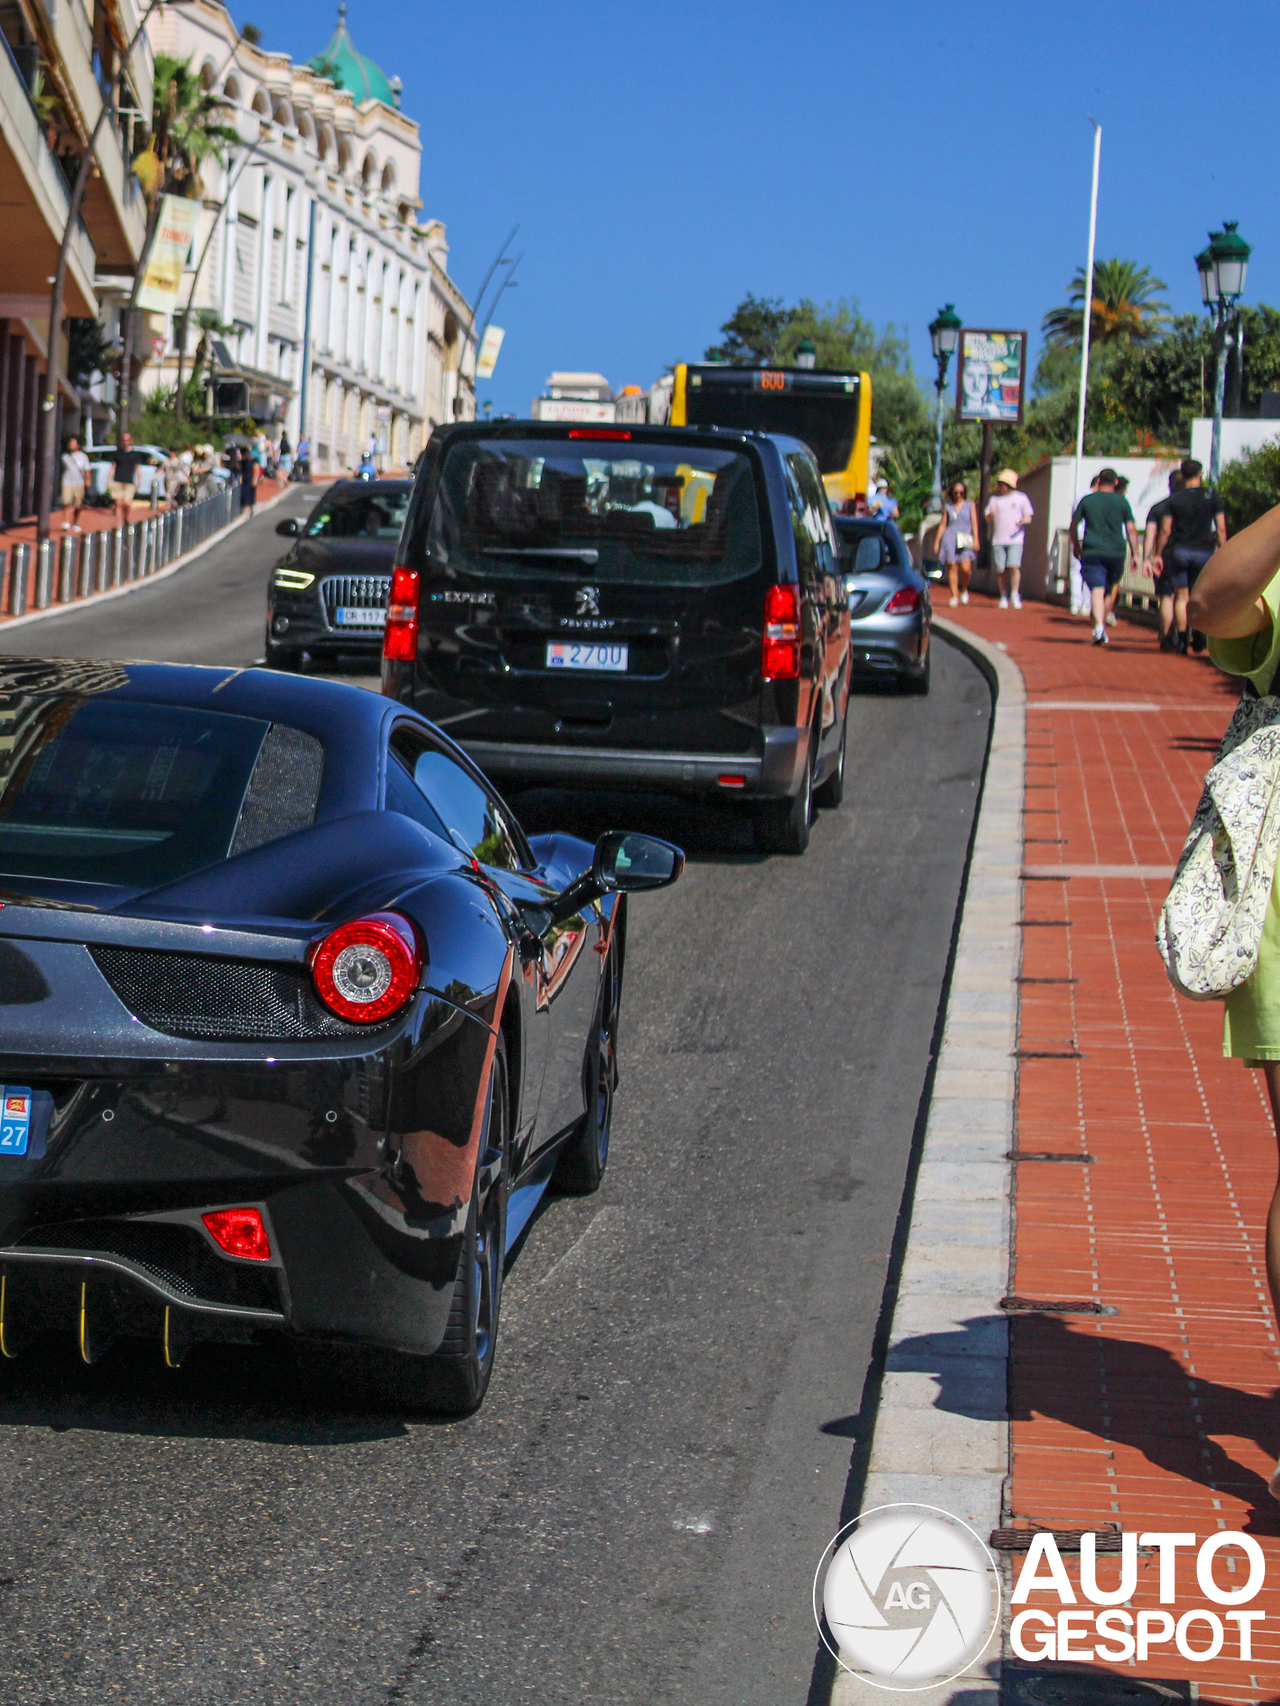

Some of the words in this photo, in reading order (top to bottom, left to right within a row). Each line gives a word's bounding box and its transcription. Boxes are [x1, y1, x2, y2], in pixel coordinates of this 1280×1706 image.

[761, 371, 785, 390] 600
[570, 645, 622, 665] 270U
[1, 1126, 27, 1147] 27
